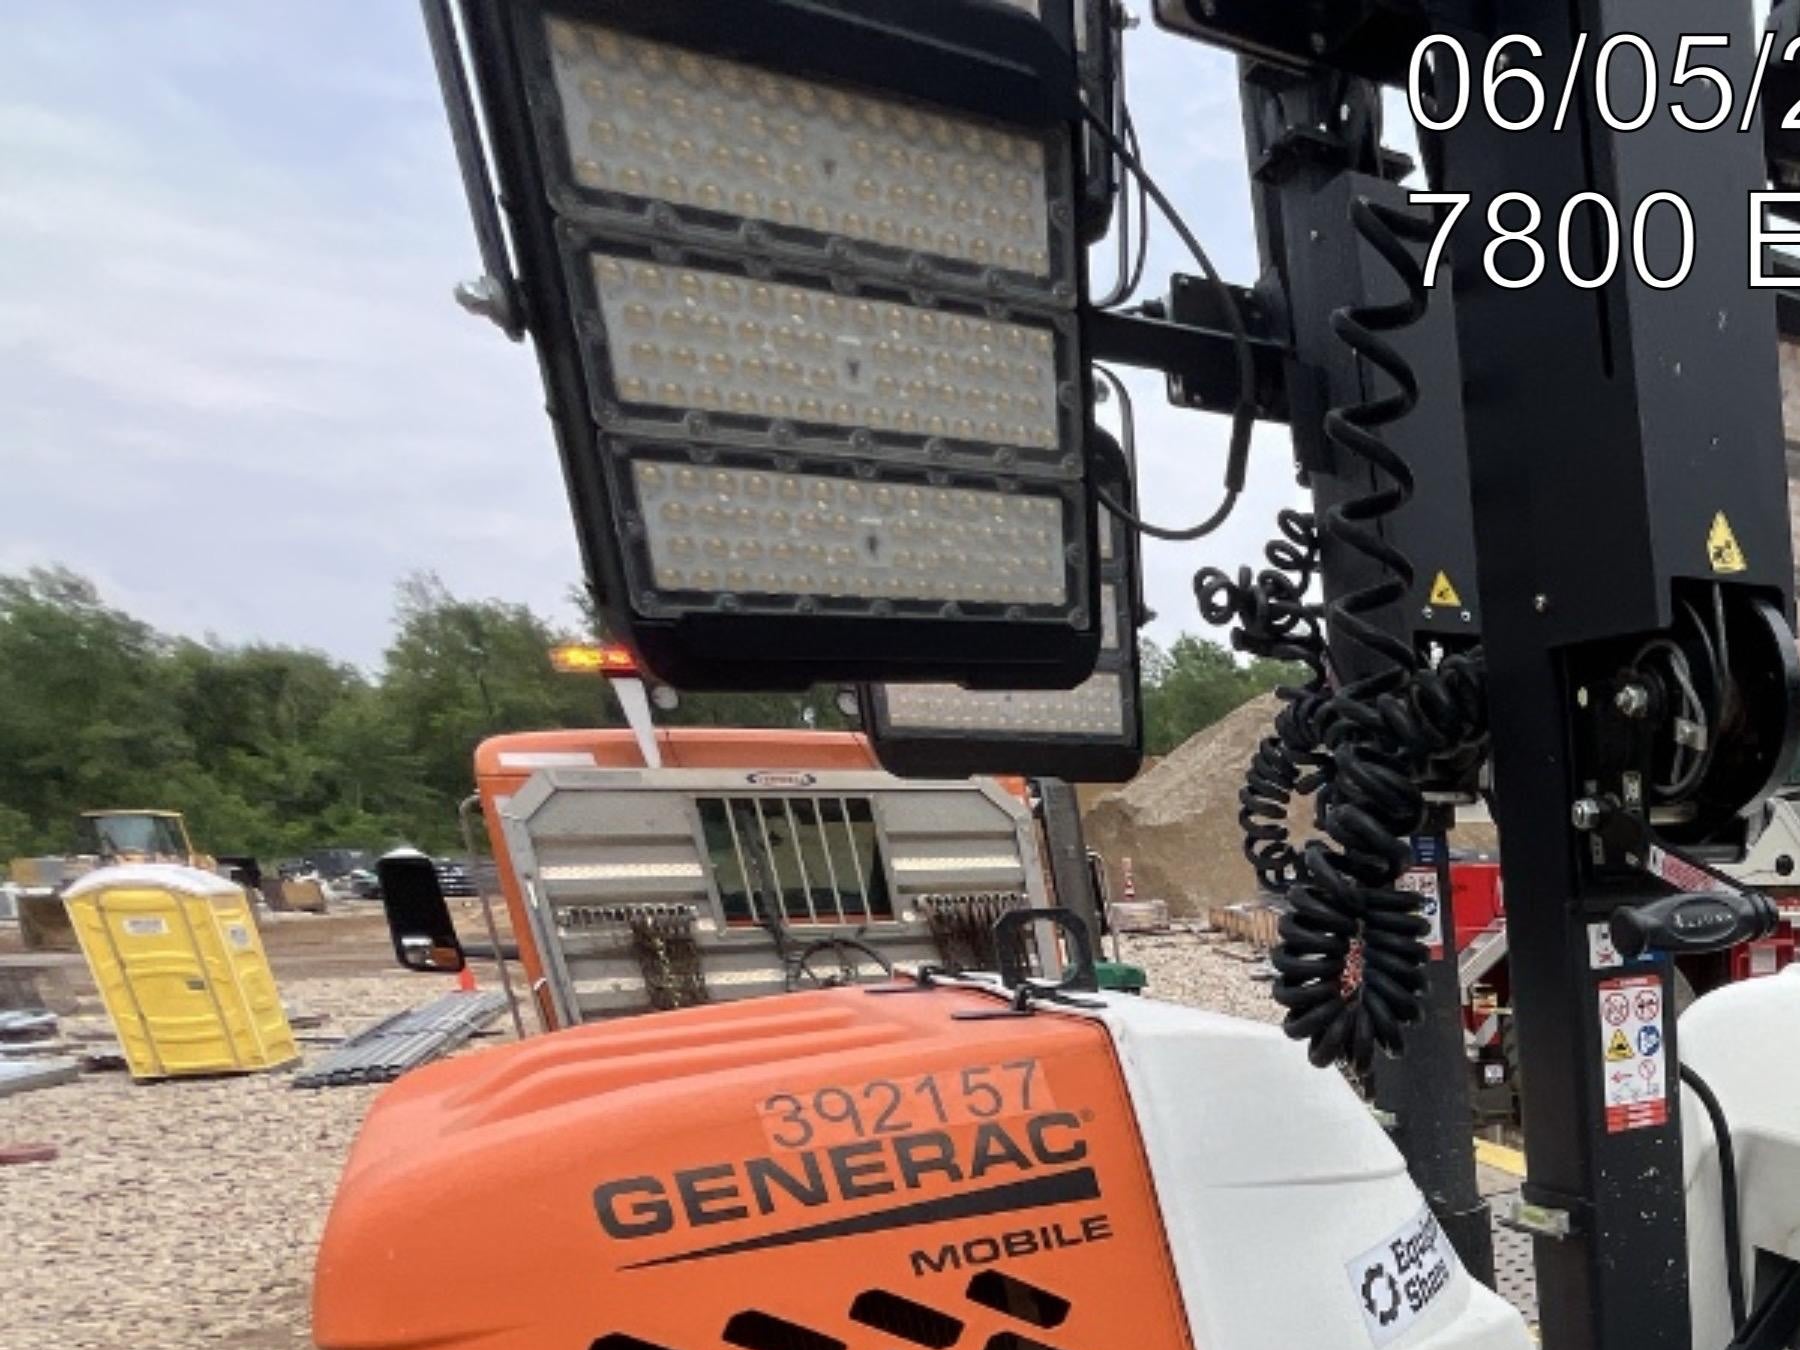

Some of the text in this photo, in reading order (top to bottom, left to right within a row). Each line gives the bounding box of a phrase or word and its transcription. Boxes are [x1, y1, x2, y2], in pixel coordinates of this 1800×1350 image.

[764, 1059, 1038, 1149] 392157
[593, 1111, 1088, 1240] GENERAC
[909, 1214, 1114, 1276] MOBILE
